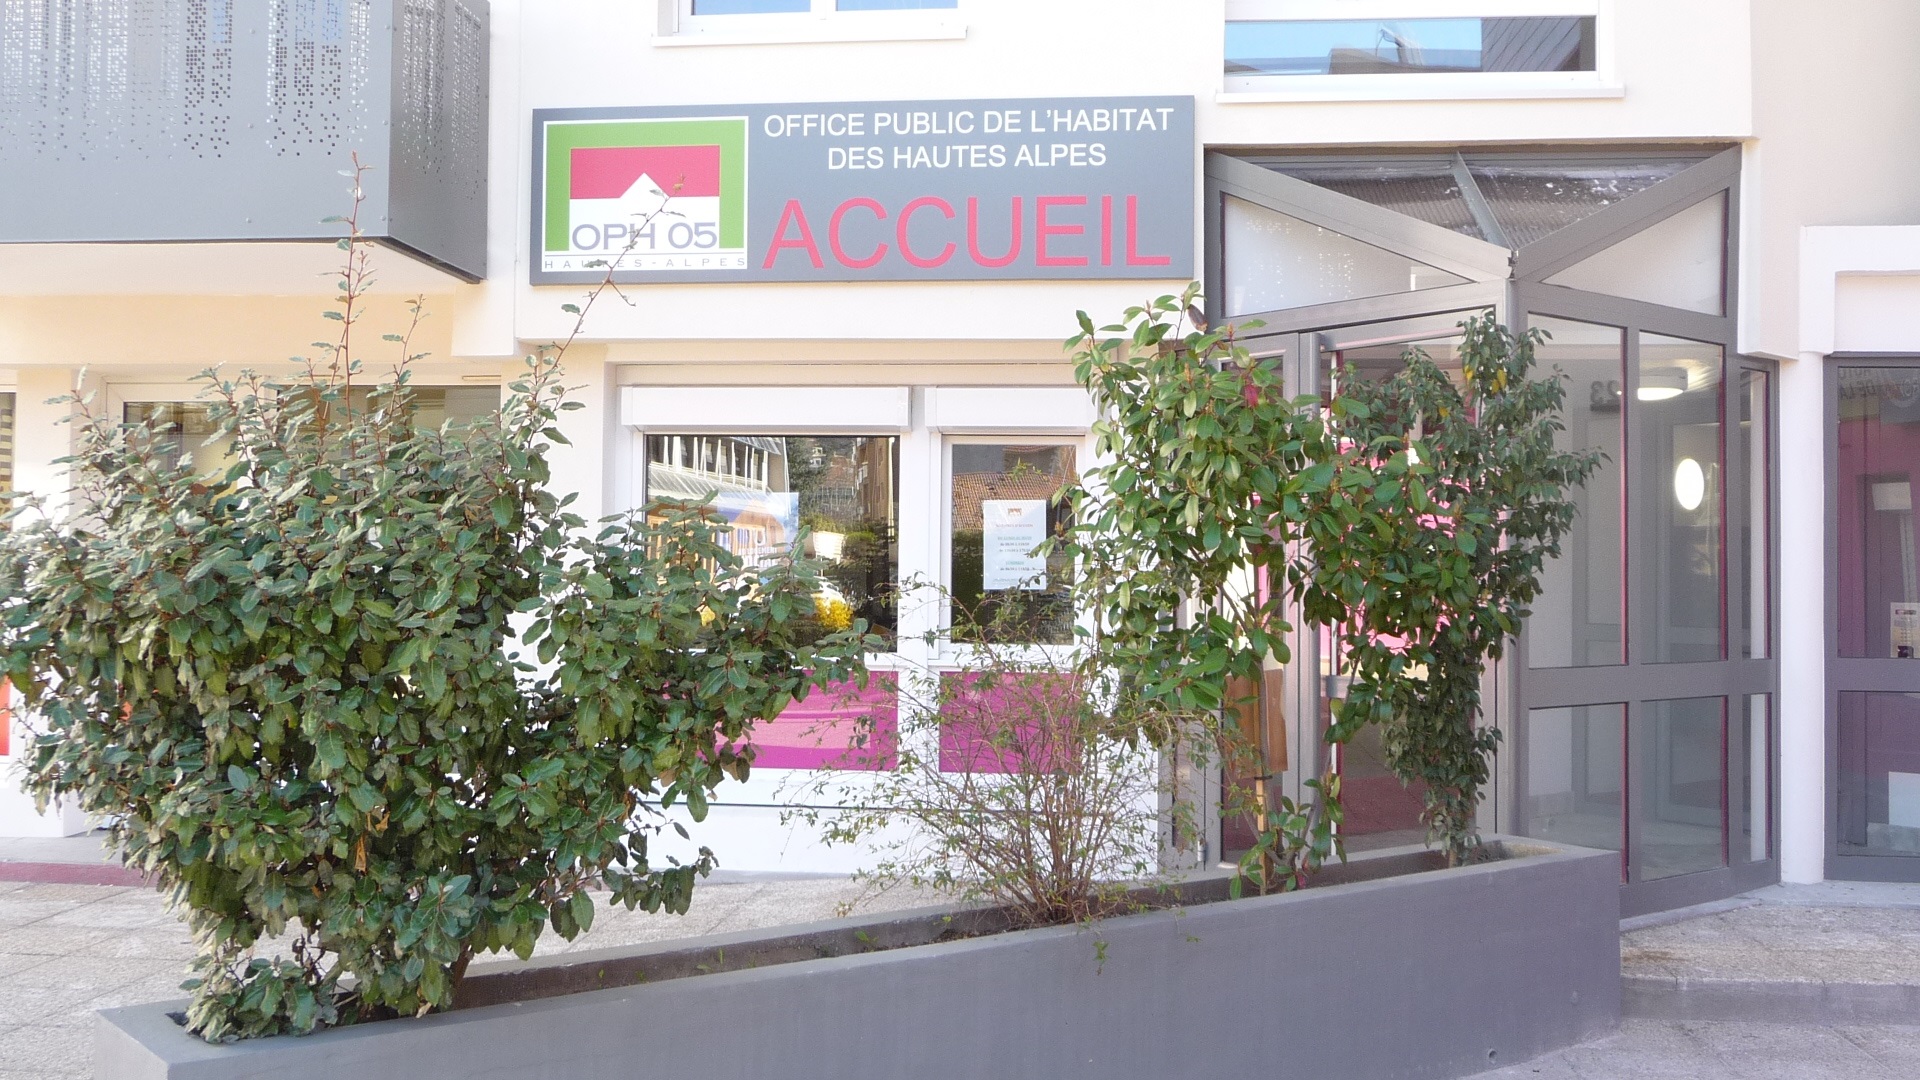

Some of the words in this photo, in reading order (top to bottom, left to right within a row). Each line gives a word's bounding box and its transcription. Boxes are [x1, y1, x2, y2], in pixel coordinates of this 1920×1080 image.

[763, 112, 865, 138] OFFICE
[874, 110, 975, 136] PUBLIC
[983, 110, 1022, 134] DE
[1030, 107, 1175, 133] L'HABITAT
[828, 146, 884, 170] DES
[893, 144, 1007, 169] HAUTES
[1013, 142, 1107, 168] ALPES
[571, 222, 656, 251] OPH
[667, 221, 718, 249] 05
[762, 195, 1172, 270] ACCUEIL
[544, 257, 746, 269] HAES-ALPES
